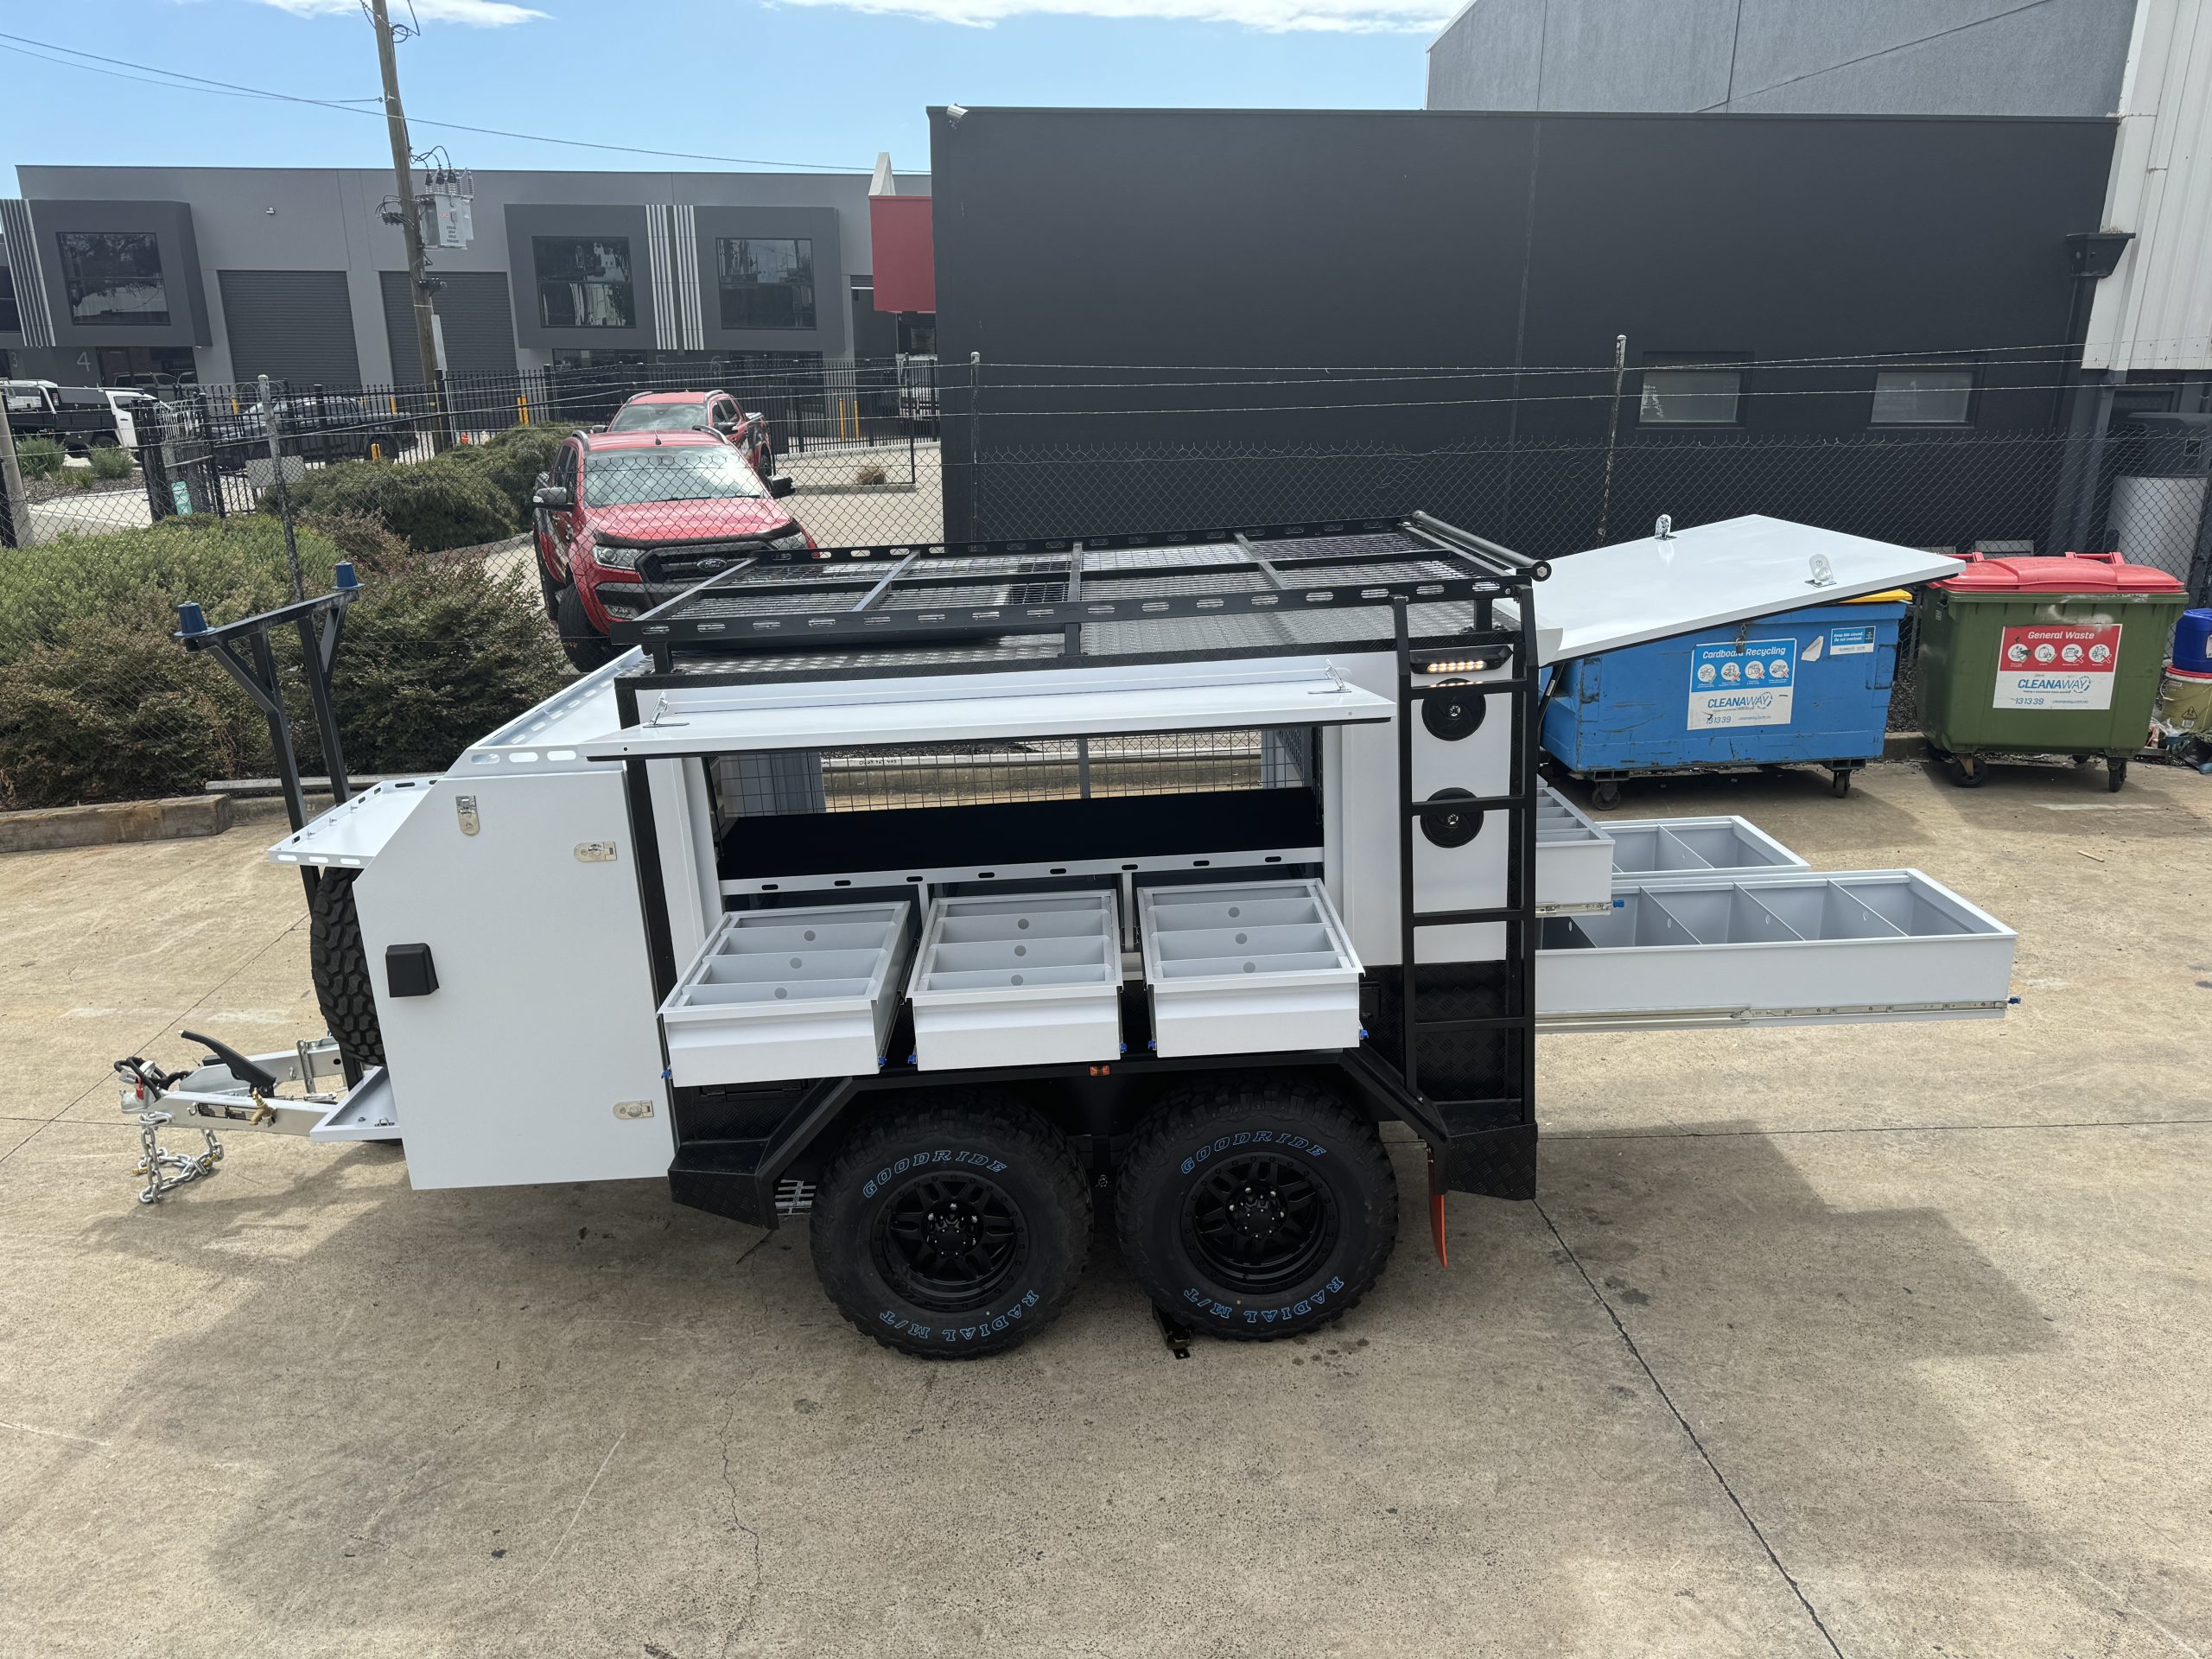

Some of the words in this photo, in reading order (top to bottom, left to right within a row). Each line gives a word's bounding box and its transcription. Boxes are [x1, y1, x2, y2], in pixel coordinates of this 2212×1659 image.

[76, 351, 91, 372] 4
[1745, 646, 1786, 656] Recycling
[2018, 678, 2087, 690] CLEANAWAY
[1707, 695, 1770, 708] CLEANAWAY
[1180, 1130, 1327, 1175] GOODRIDE
[862, 1149, 1007, 1198] GOODRIDE
[1183, 1287, 1233, 1319] M/T
[1243, 1276, 1344, 1323] RADIAL
[879, 1311, 931, 1339] M/T
[942, 1290, 1039, 1342] RADIAL
